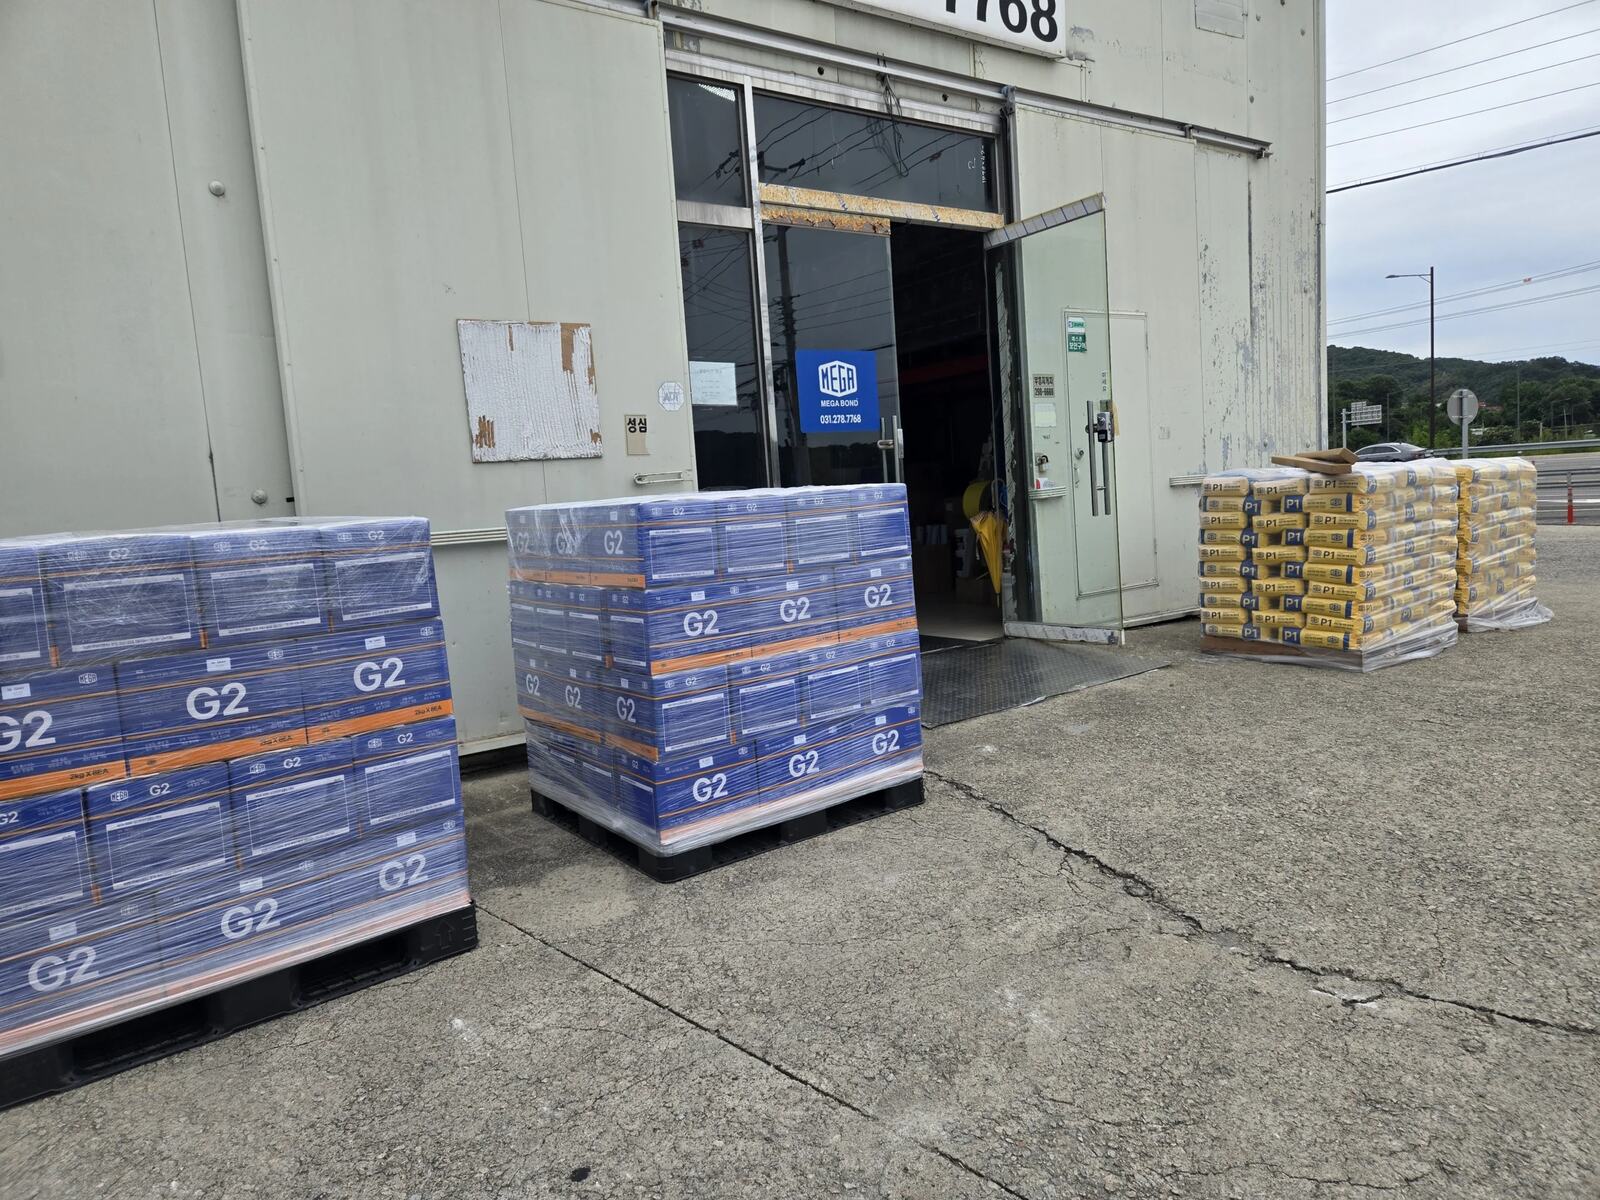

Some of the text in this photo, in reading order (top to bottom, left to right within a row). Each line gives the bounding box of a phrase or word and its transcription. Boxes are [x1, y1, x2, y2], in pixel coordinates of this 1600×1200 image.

[821, 364, 855, 393] MEGA
[840, 399, 859, 407] BOND
[820, 414, 862, 424] 031.278.7768
[627, 417, 648, 433] 성심
[1324, 480, 1336, 488] P1
[747, 503, 758, 511] G2
[1244, 503, 1258, 512] P1
[1286, 500, 1300, 509] P1
[673, 507, 685, 516] G2
[368, 530, 386, 540] G2
[1242, 535, 1255, 544] P1
[1288, 532, 1301, 541] P1
[604, 530, 624, 554] G2
[1323, 551, 1335, 559] P1
[1242, 567, 1255, 576] P1
[1287, 565, 1300, 574] P1
[864, 584, 893, 608] G2
[1243, 599, 1256, 607] P1
[1286, 598, 1299, 608] P1
[780, 597, 811, 622] G2
[684, 610, 720, 636] G2
[1320, 618, 1333, 627] P1
[1244, 629, 1257, 638] P1
[1284, 631, 1298, 640] P1
[886, 640, 896, 648] G2
[826, 651, 836, 659] G2
[760, 663, 771, 672] G2
[79, 673, 97, 684] MEGA
[353, 657, 406, 692] G2
[526, 674, 540, 696] G2
[685, 676, 697, 686] G2
[186, 682, 249, 720] G2
[565, 685, 582, 709] G2
[616, 697, 636, 723] G2
[397, 733, 413, 744] G2
[872, 729, 900, 755] G2
[283, 757, 301, 768] G2
[789, 750, 820, 777] G2
[150, 783, 170, 796] G2
[693, 773, 728, 802] G2
[111, 790, 129, 801] MEGA
[379, 854, 428, 891] G2
[220, 898, 280, 939] G2
[28, 946, 99, 991] G2
